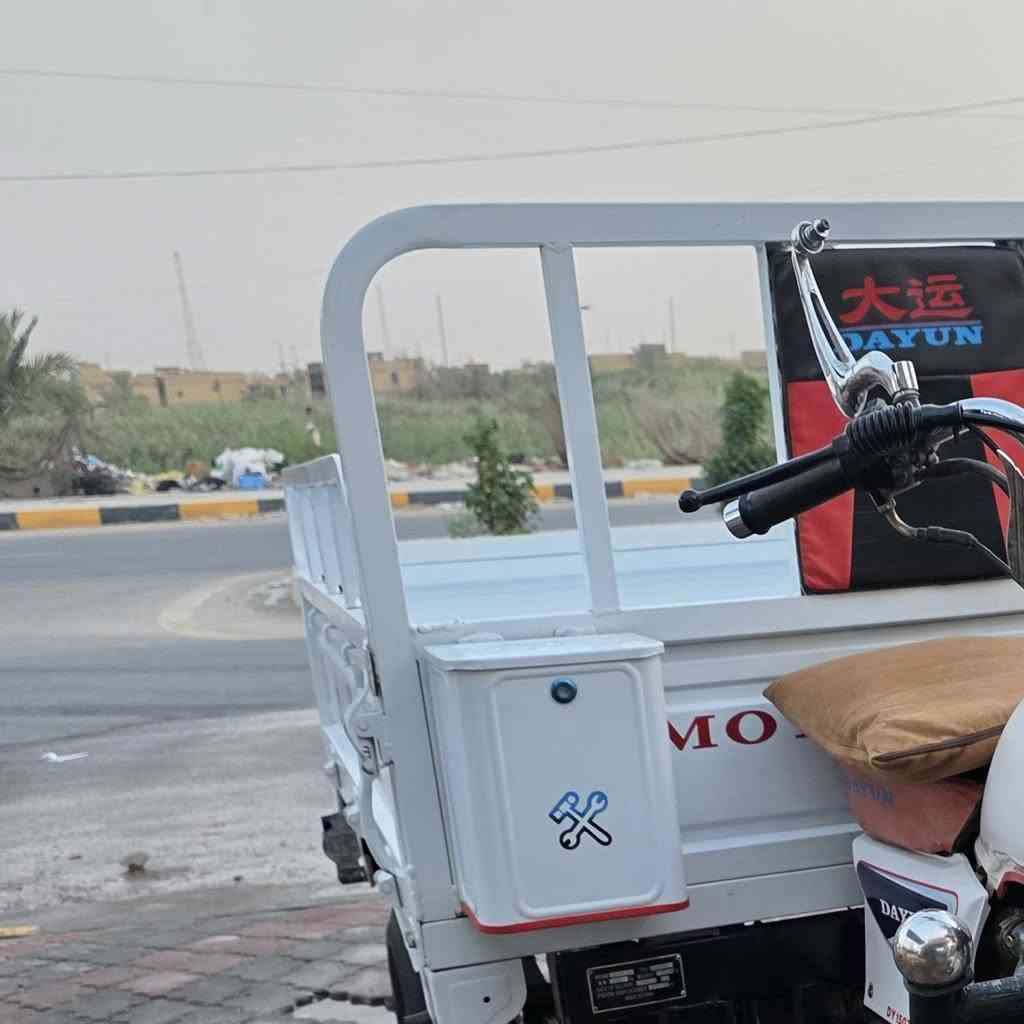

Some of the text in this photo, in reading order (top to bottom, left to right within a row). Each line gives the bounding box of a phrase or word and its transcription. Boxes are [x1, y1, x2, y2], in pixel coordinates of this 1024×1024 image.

[839, 273, 973, 324] 大运
[842, 325, 983, 350] DAYUN
[666, 710, 806, 751] MO
[879, 898, 914, 924] DAY
